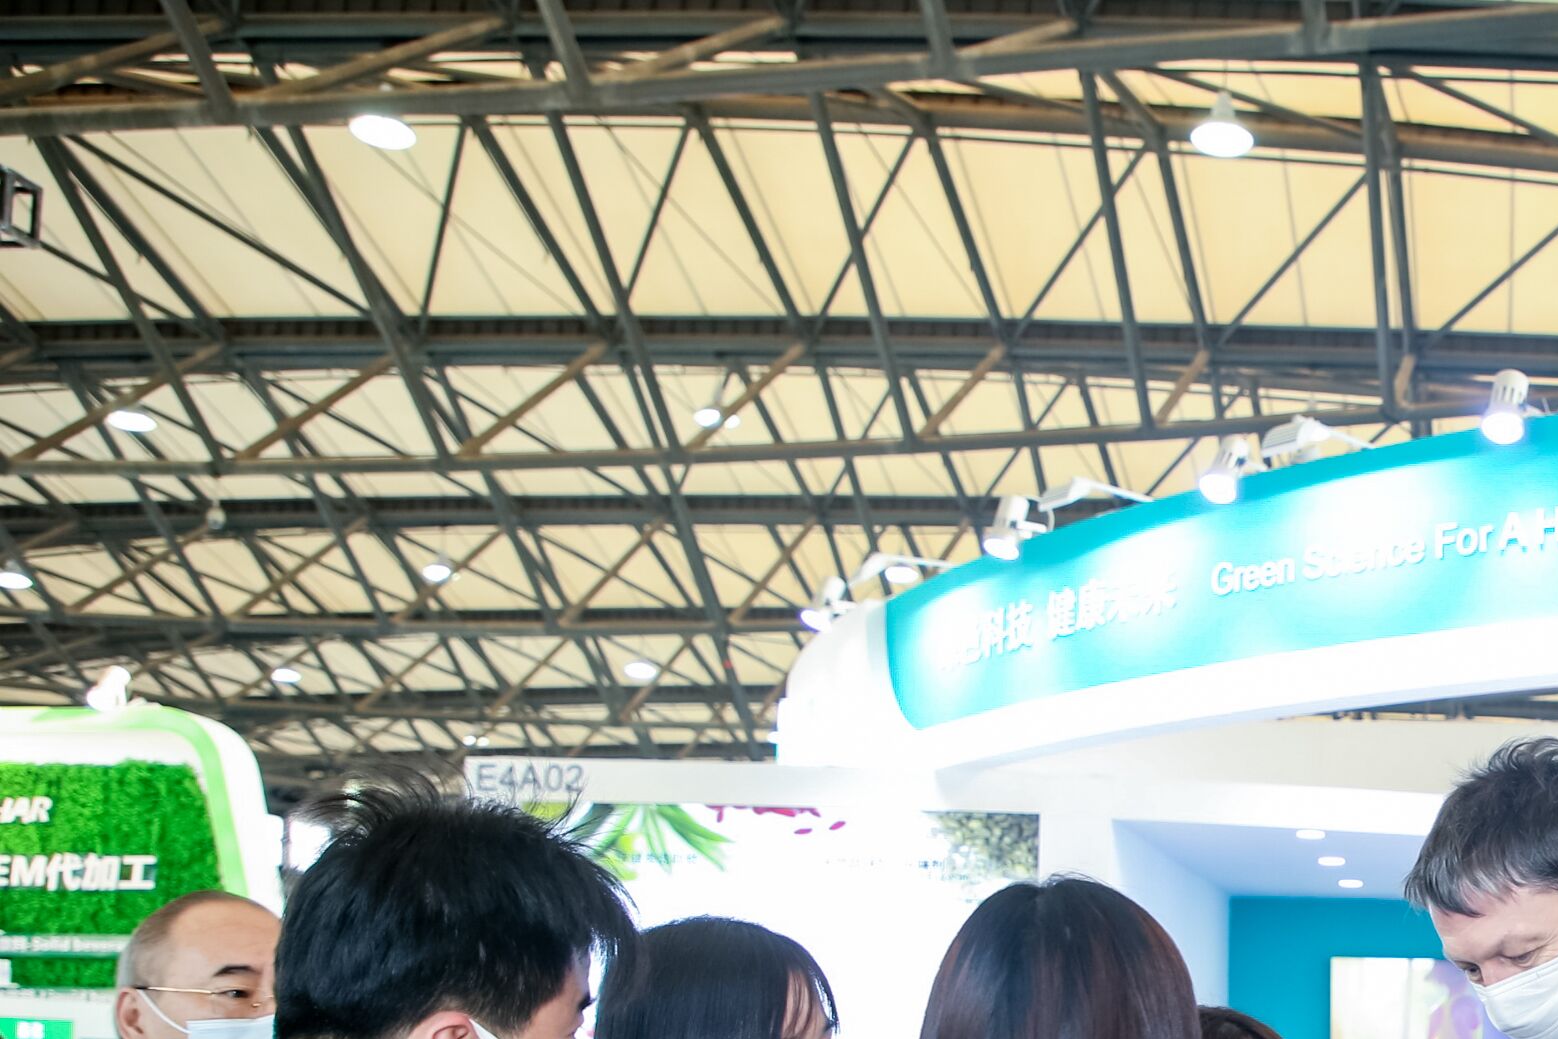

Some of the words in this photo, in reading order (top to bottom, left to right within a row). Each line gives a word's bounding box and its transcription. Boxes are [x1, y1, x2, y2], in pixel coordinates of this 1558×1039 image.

[1211, 557, 1297, 596] Green
[1302, 536, 1426, 581] Science
[1433, 521, 1494, 560] For
[1498, 510, 1529, 554] A
[476, 763, 584, 792] E4A02
